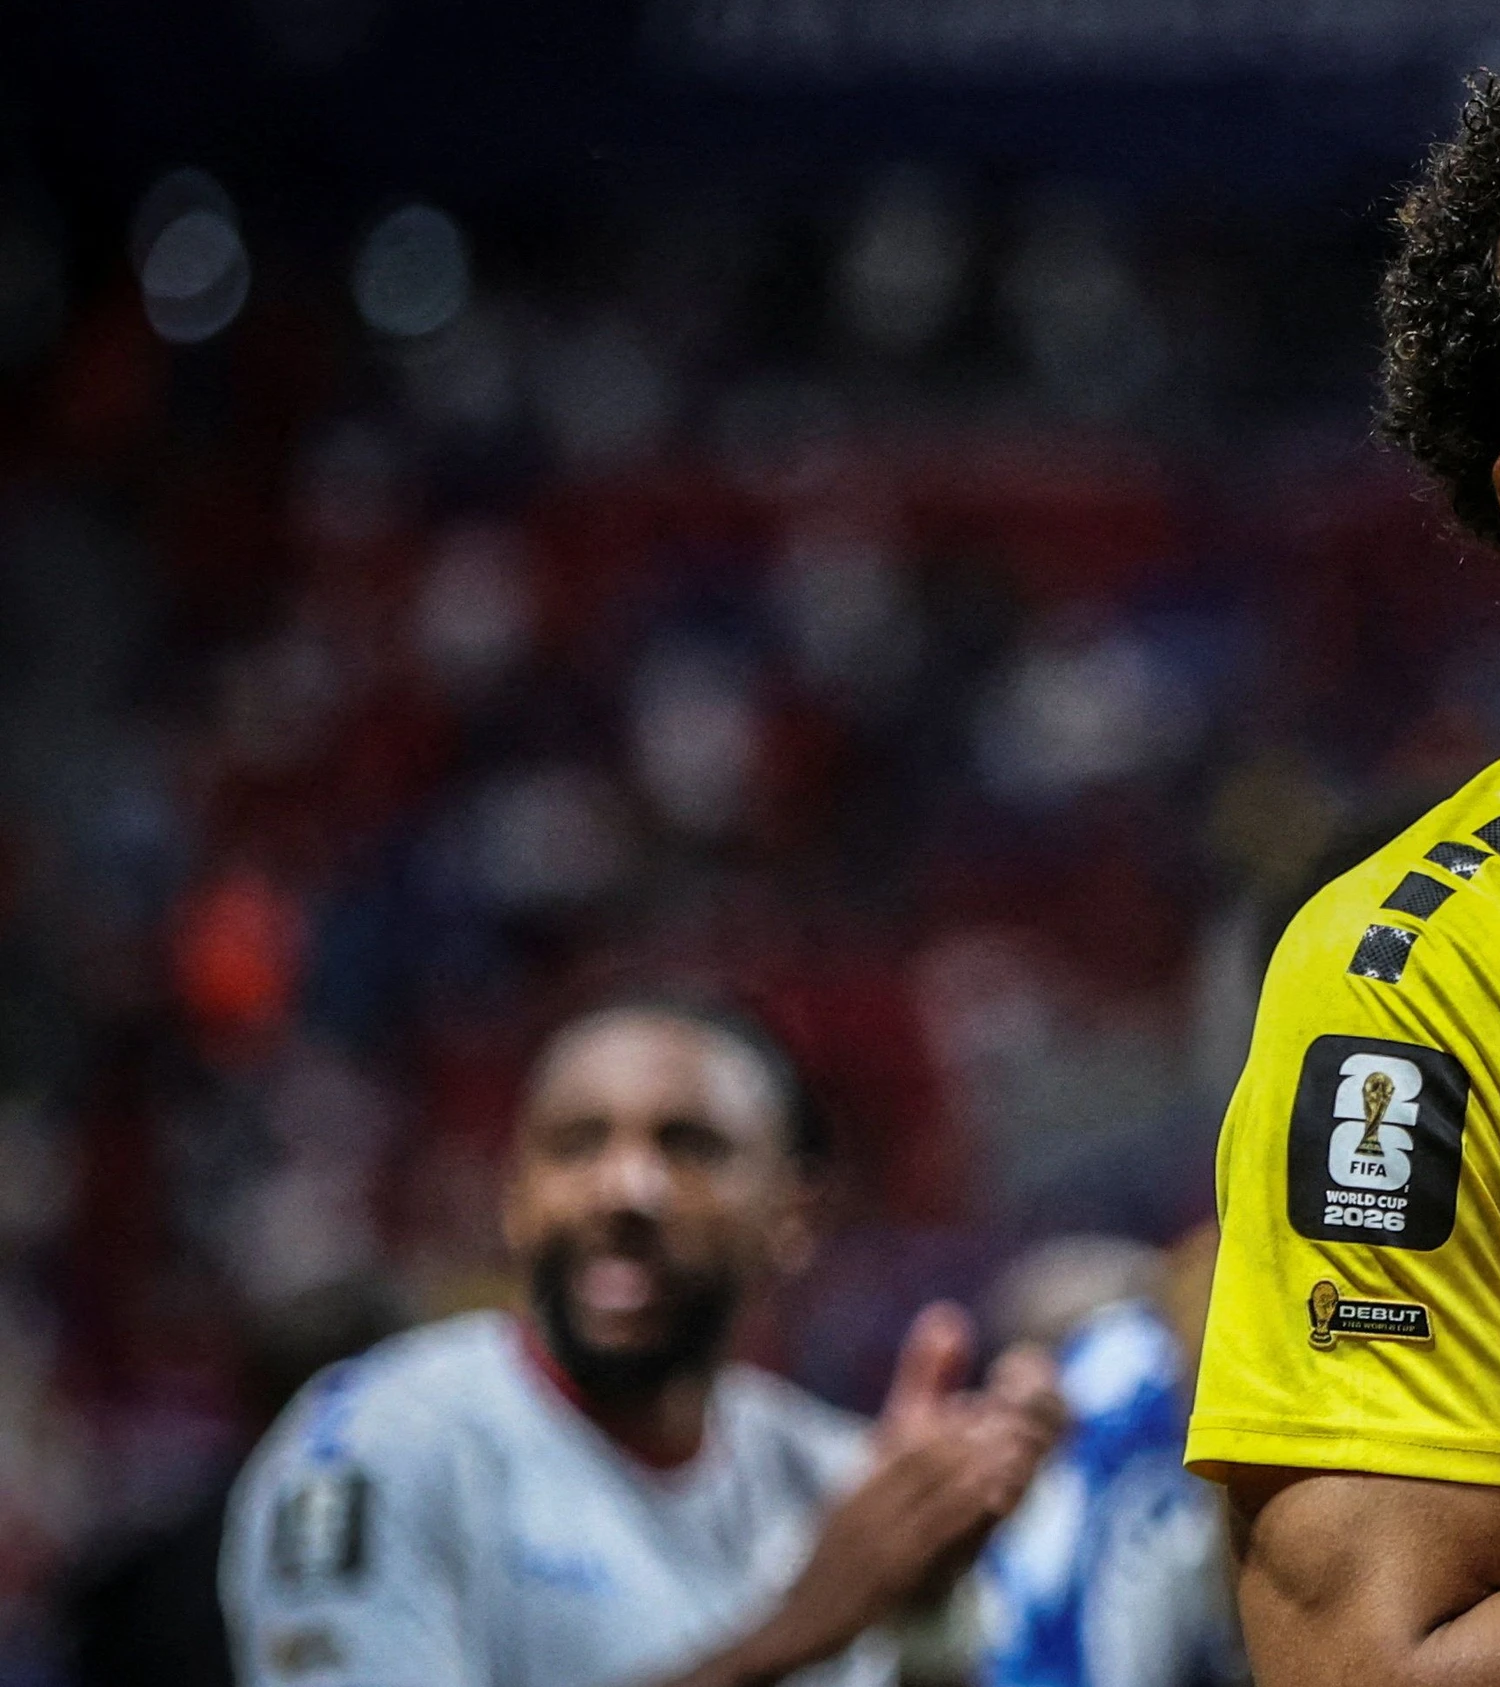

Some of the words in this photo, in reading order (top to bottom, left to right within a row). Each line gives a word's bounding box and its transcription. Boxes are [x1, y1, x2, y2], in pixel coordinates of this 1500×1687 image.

[1350, 1161, 1387, 1177] FIFA
[1326, 1190, 1376, 1206] WORLD
[1377, 1195, 1407, 1210] CUP
[1324, 1205, 1406, 1232] 2026
[1339, 1305, 1421, 1323] DEBUT
